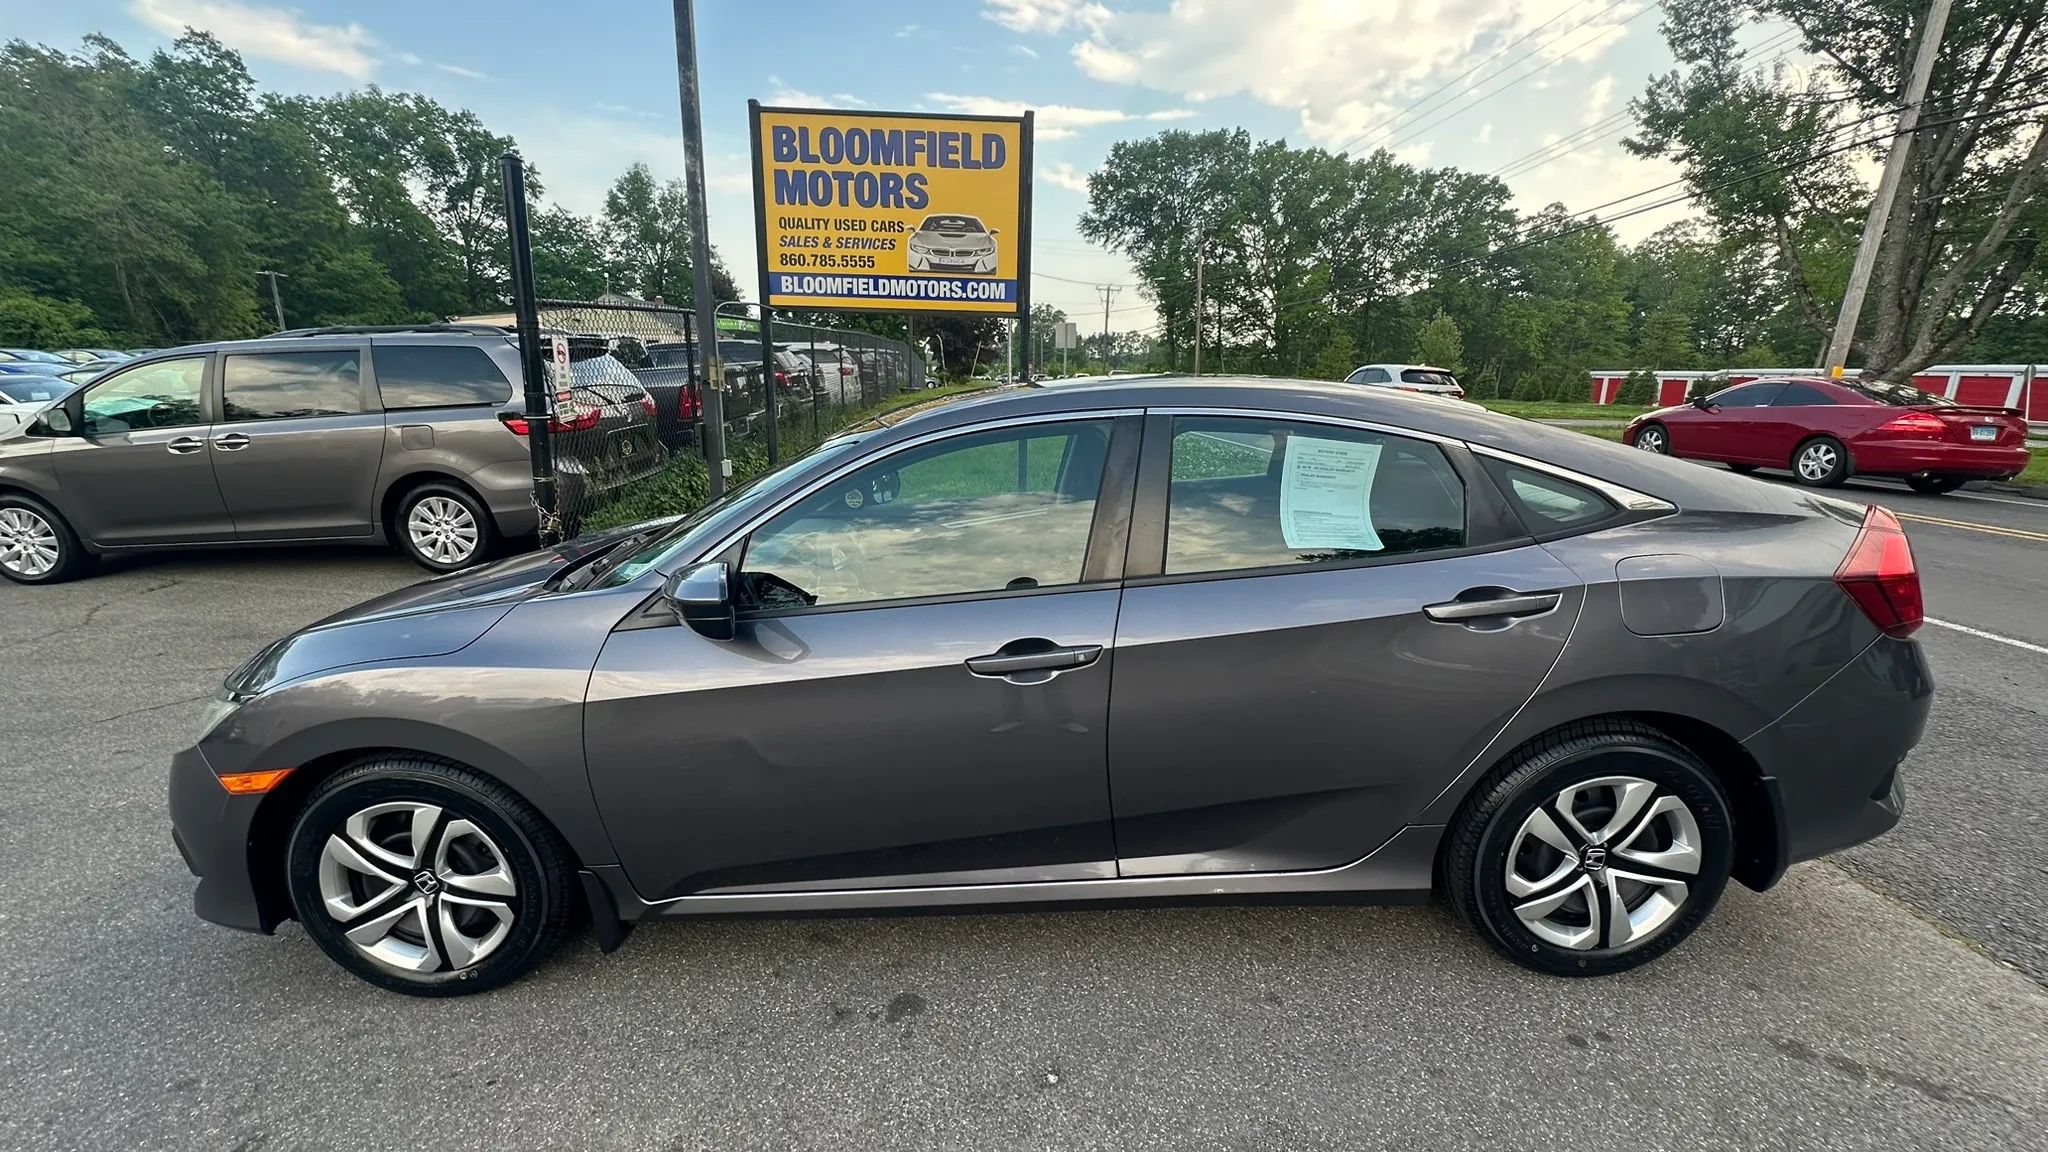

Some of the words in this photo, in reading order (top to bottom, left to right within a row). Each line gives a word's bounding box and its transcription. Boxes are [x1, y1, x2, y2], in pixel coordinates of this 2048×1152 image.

[773, 126, 1005, 169] BLOOMFIELD
[774, 169, 928, 209] MOTORS
[779, 216, 830, 231] QUALITY
[834, 218, 867, 232] USED
[871, 220, 904, 233] CARS
[779, 235, 819, 248] SALES
[823, 237, 832, 248] &
[836, 237, 896, 251] SERVICES
[780, 253, 875, 268] 860.785.5555
[782, 276, 1005, 299] BLOOMFIELDMOTORS.COM
